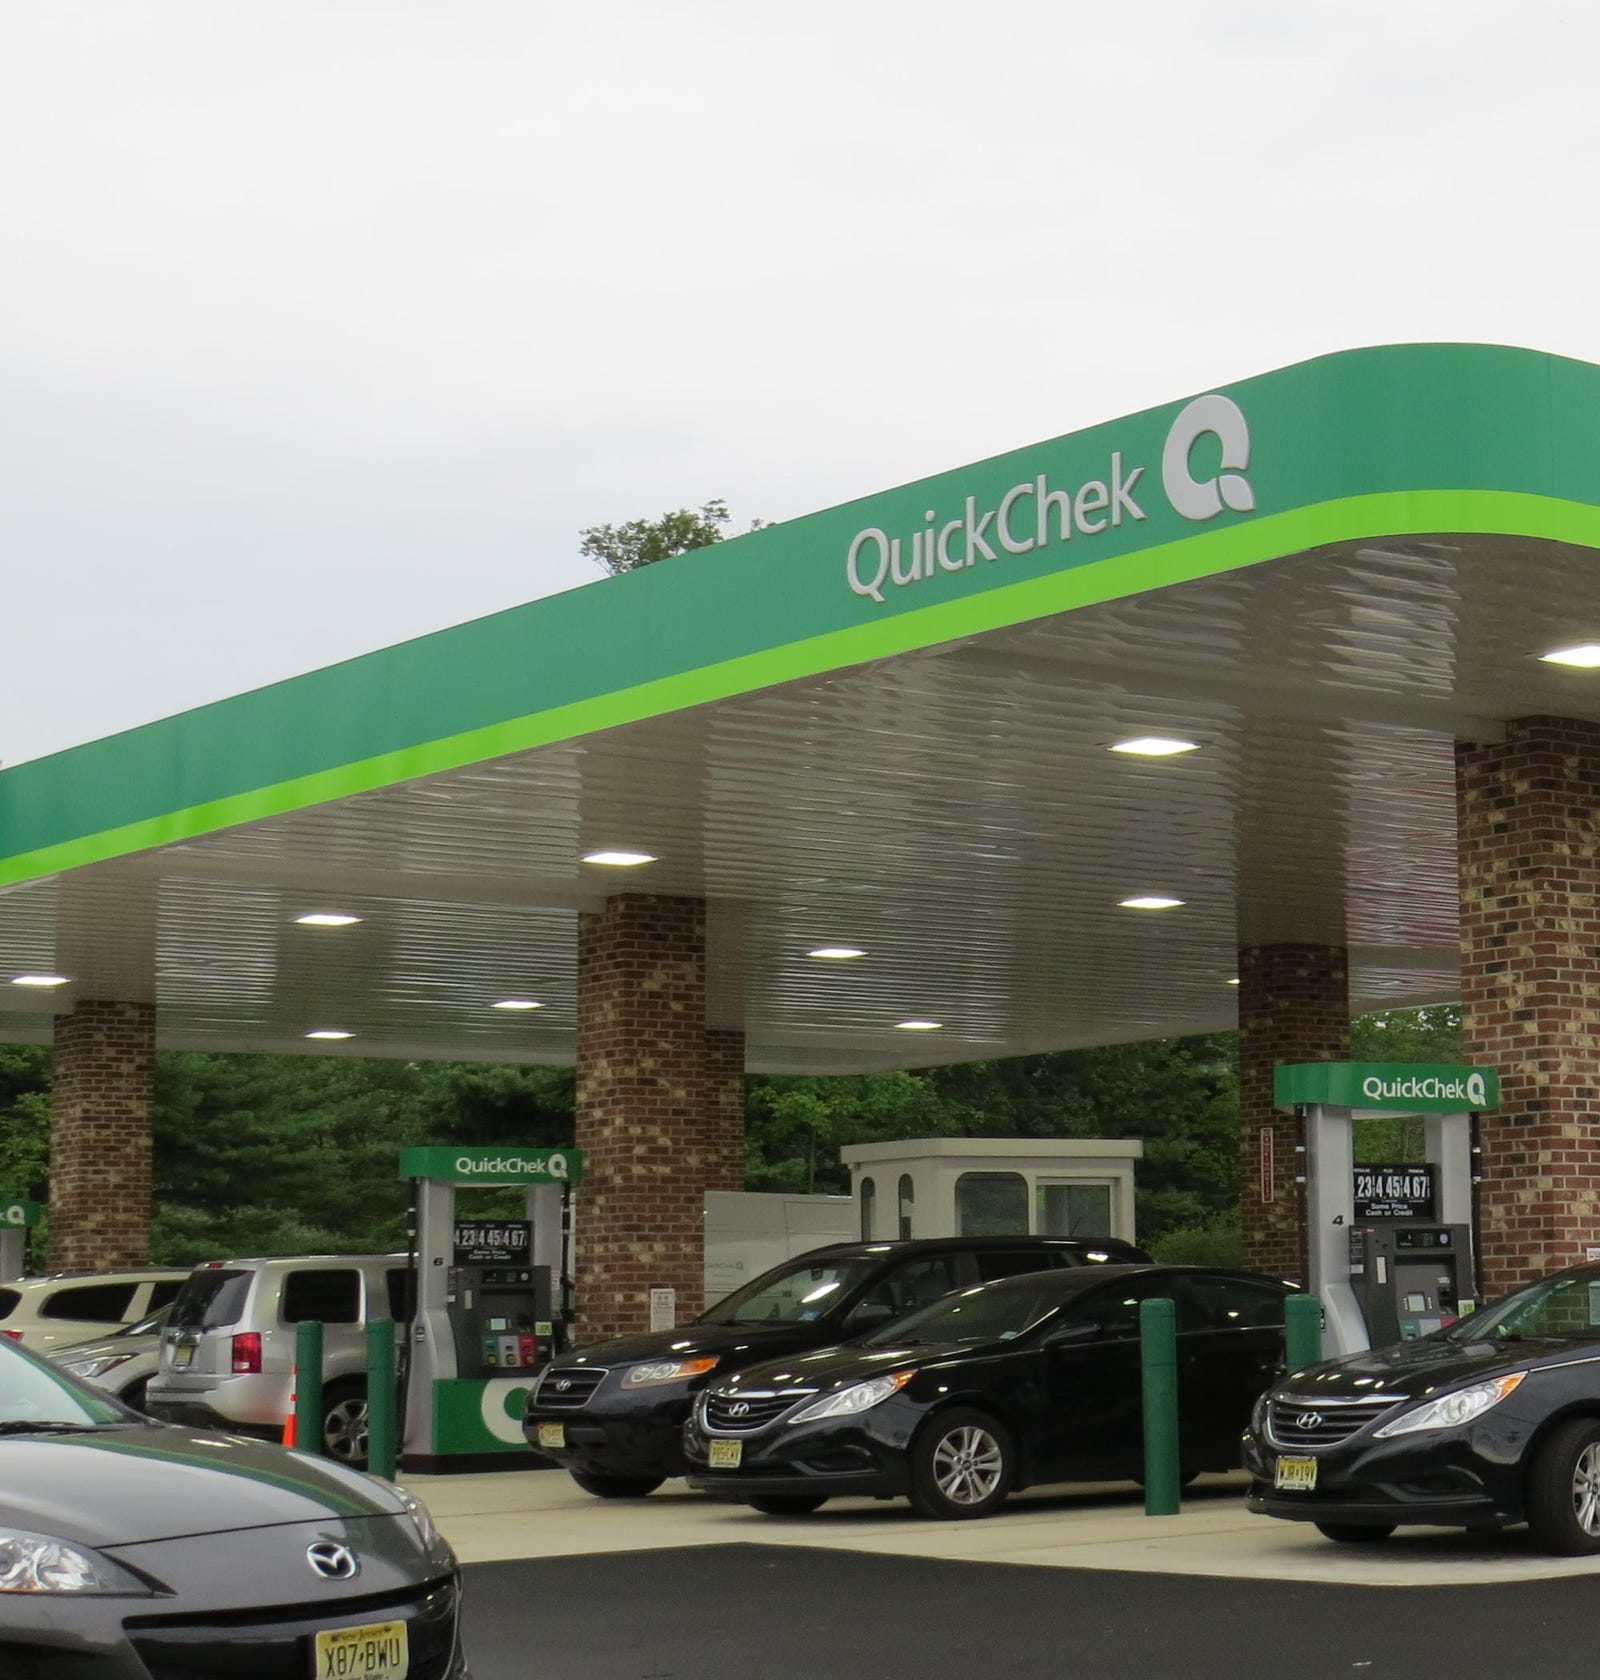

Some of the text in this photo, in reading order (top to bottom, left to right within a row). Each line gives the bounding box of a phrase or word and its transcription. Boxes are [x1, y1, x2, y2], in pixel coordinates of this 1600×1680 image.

[847, 452, 1148, 603] QuickChek
[1362, 1076, 1466, 1101] QuickChek
[455, 1156, 547, 1175] QuickChek
[1332, 1214, 1345, 1226] 4
[433, 1257, 444, 1267] 6
